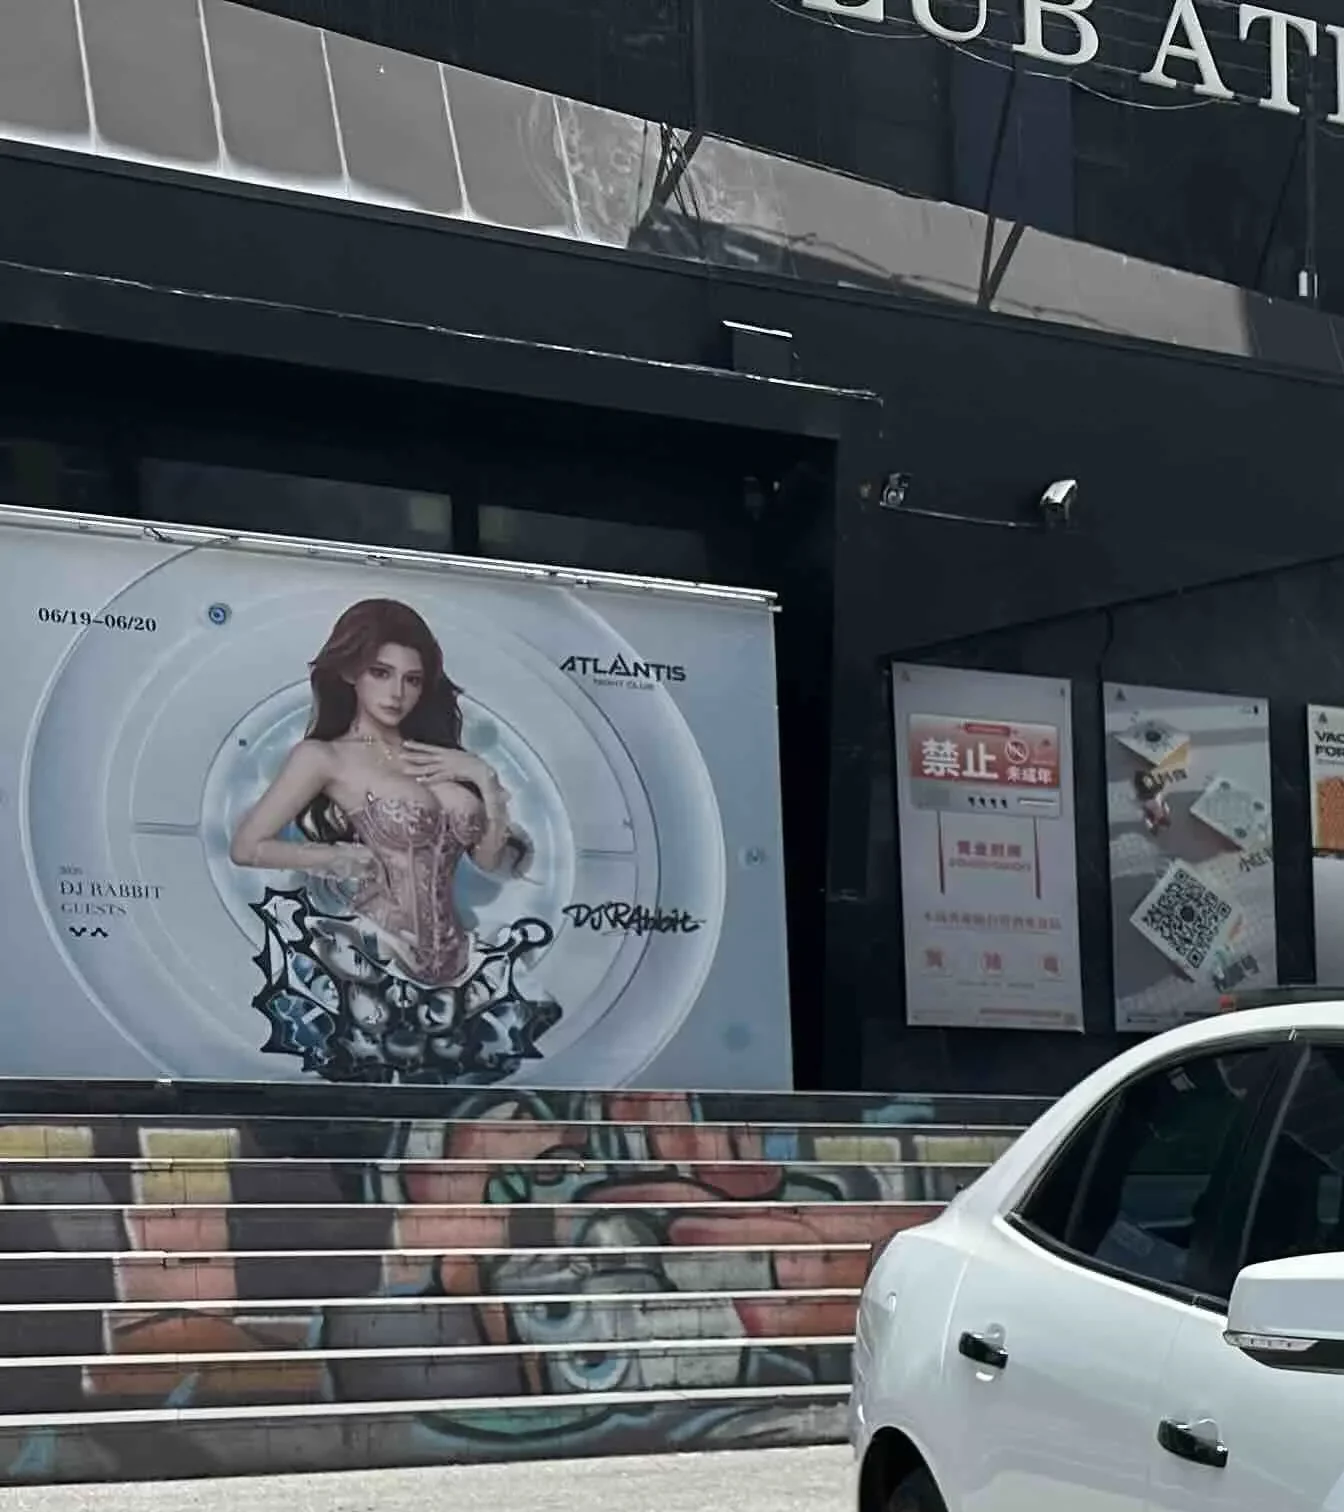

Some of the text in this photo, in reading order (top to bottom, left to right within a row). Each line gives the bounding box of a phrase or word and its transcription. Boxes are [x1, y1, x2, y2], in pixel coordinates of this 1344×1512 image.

[37, 606, 157, 633] 06/19-06/20
[560, 653, 686, 682] ATLANTIS
[922, 736, 999, 780] 禁止
[60, 879, 165, 899] DJ RABBIT
[60, 902, 127, 915] GUESTS
